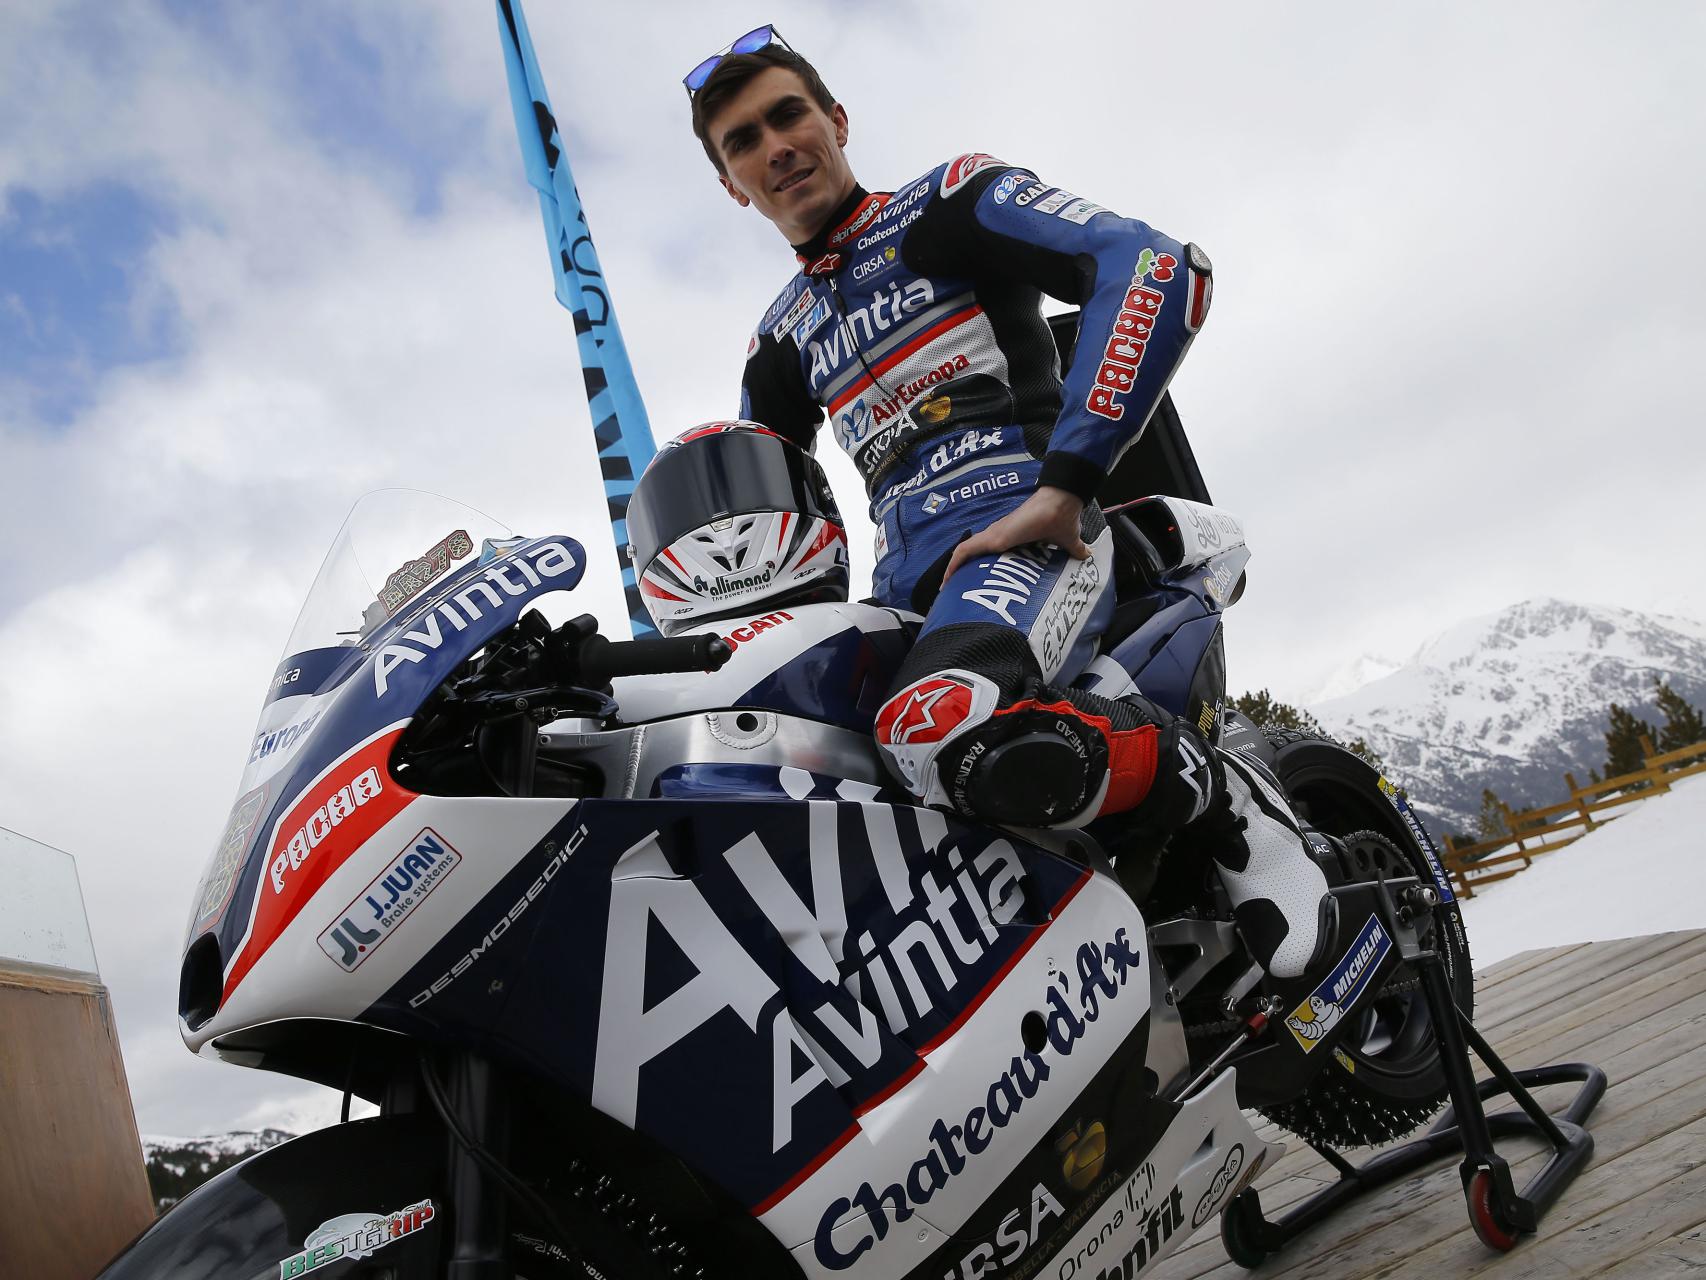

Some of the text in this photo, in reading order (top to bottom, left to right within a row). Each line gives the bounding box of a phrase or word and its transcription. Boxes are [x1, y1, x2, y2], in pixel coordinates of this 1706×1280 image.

[857, 223, 899, 250] Chateau
[866, 182, 929, 230] Avintia
[853, 255, 885, 279] CIRSA
[778, 289, 811, 334] LS2
[808, 278, 934, 390] Avintia
[871, 354, 970, 425] AirEuropa
[1086, 285, 1165, 421] PACHA
[950, 471, 1019, 502] remica
[709, 569, 771, 597] allimand
[725, 590, 744, 599] power
[755, 583, 773, 593] paper
[374, 542, 576, 699] Avintia
[722, 611, 794, 653] UCATI
[955, 740, 987, 786] RACING
[1055, 719, 1088, 759] AHEAD
[270, 766, 383, 894] PACHA
[1402, 810, 1449, 891] MICHELIN
[364, 835, 445, 920] J.JUAN
[381, 854, 454, 929] Brake systems
[408, 823, 589, 1009] DESMOSEDICI
[773, 838, 1028, 1154] Avintia
[1332, 924, 1383, 1000] MICHELIN
[814, 927, 1142, 1270] Chateau d'Ax
[282, 1206, 433, 1280] BESTGRIP
[944, 1182, 1066, 1280] RSA
[1059, 1209, 1124, 1280] Orona
